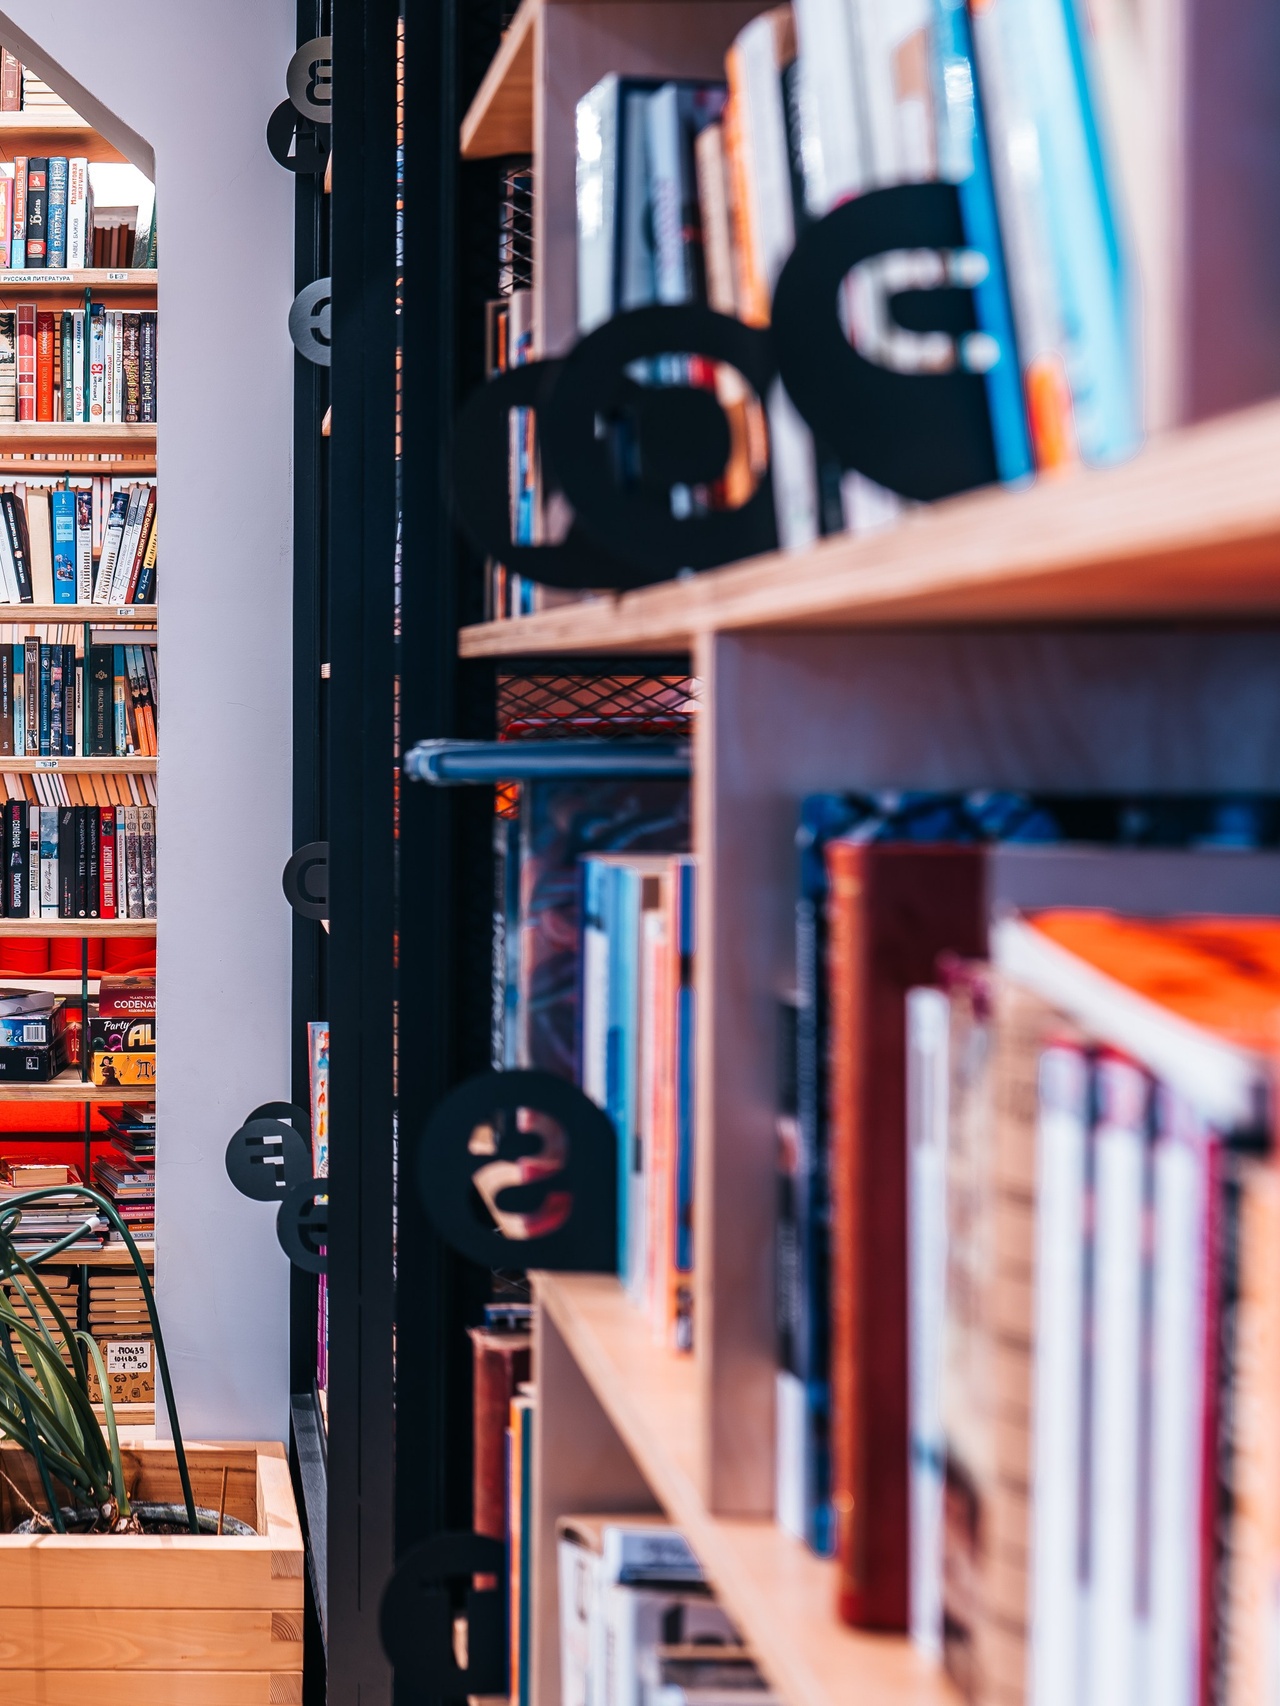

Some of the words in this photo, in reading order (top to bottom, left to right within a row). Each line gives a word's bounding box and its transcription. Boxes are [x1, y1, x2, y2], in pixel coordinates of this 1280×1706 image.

[16, 170, 24, 198] БАБЕЛЬ
[70, 163, 78, 205] Малахитовая
[16, 199, 24, 219] Исаак
[29, 198, 42, 226] Бабель
[91, 364, 103, 376] 13
[146, 502, 154, 517] ДОМА
[140, 518, 150, 538] СТАРОГО
[137, 539, 146, 557] СКАЗКИ
[101, 552, 116, 600] КРАПИВИН
[12, 805, 21, 820] МАРИЯ
[78, 860, 86, 876] ТРОЕ
[103, 844, 114, 881] СПАНГЕНБЕРГ
[13, 872, 22, 908] ВОЛКОДАВ
[103, 882, 114, 907] ЕВГЕНИЙ
[103, 1020, 130, 1033] Party
[118, 1346, 144, 1354] 170439
